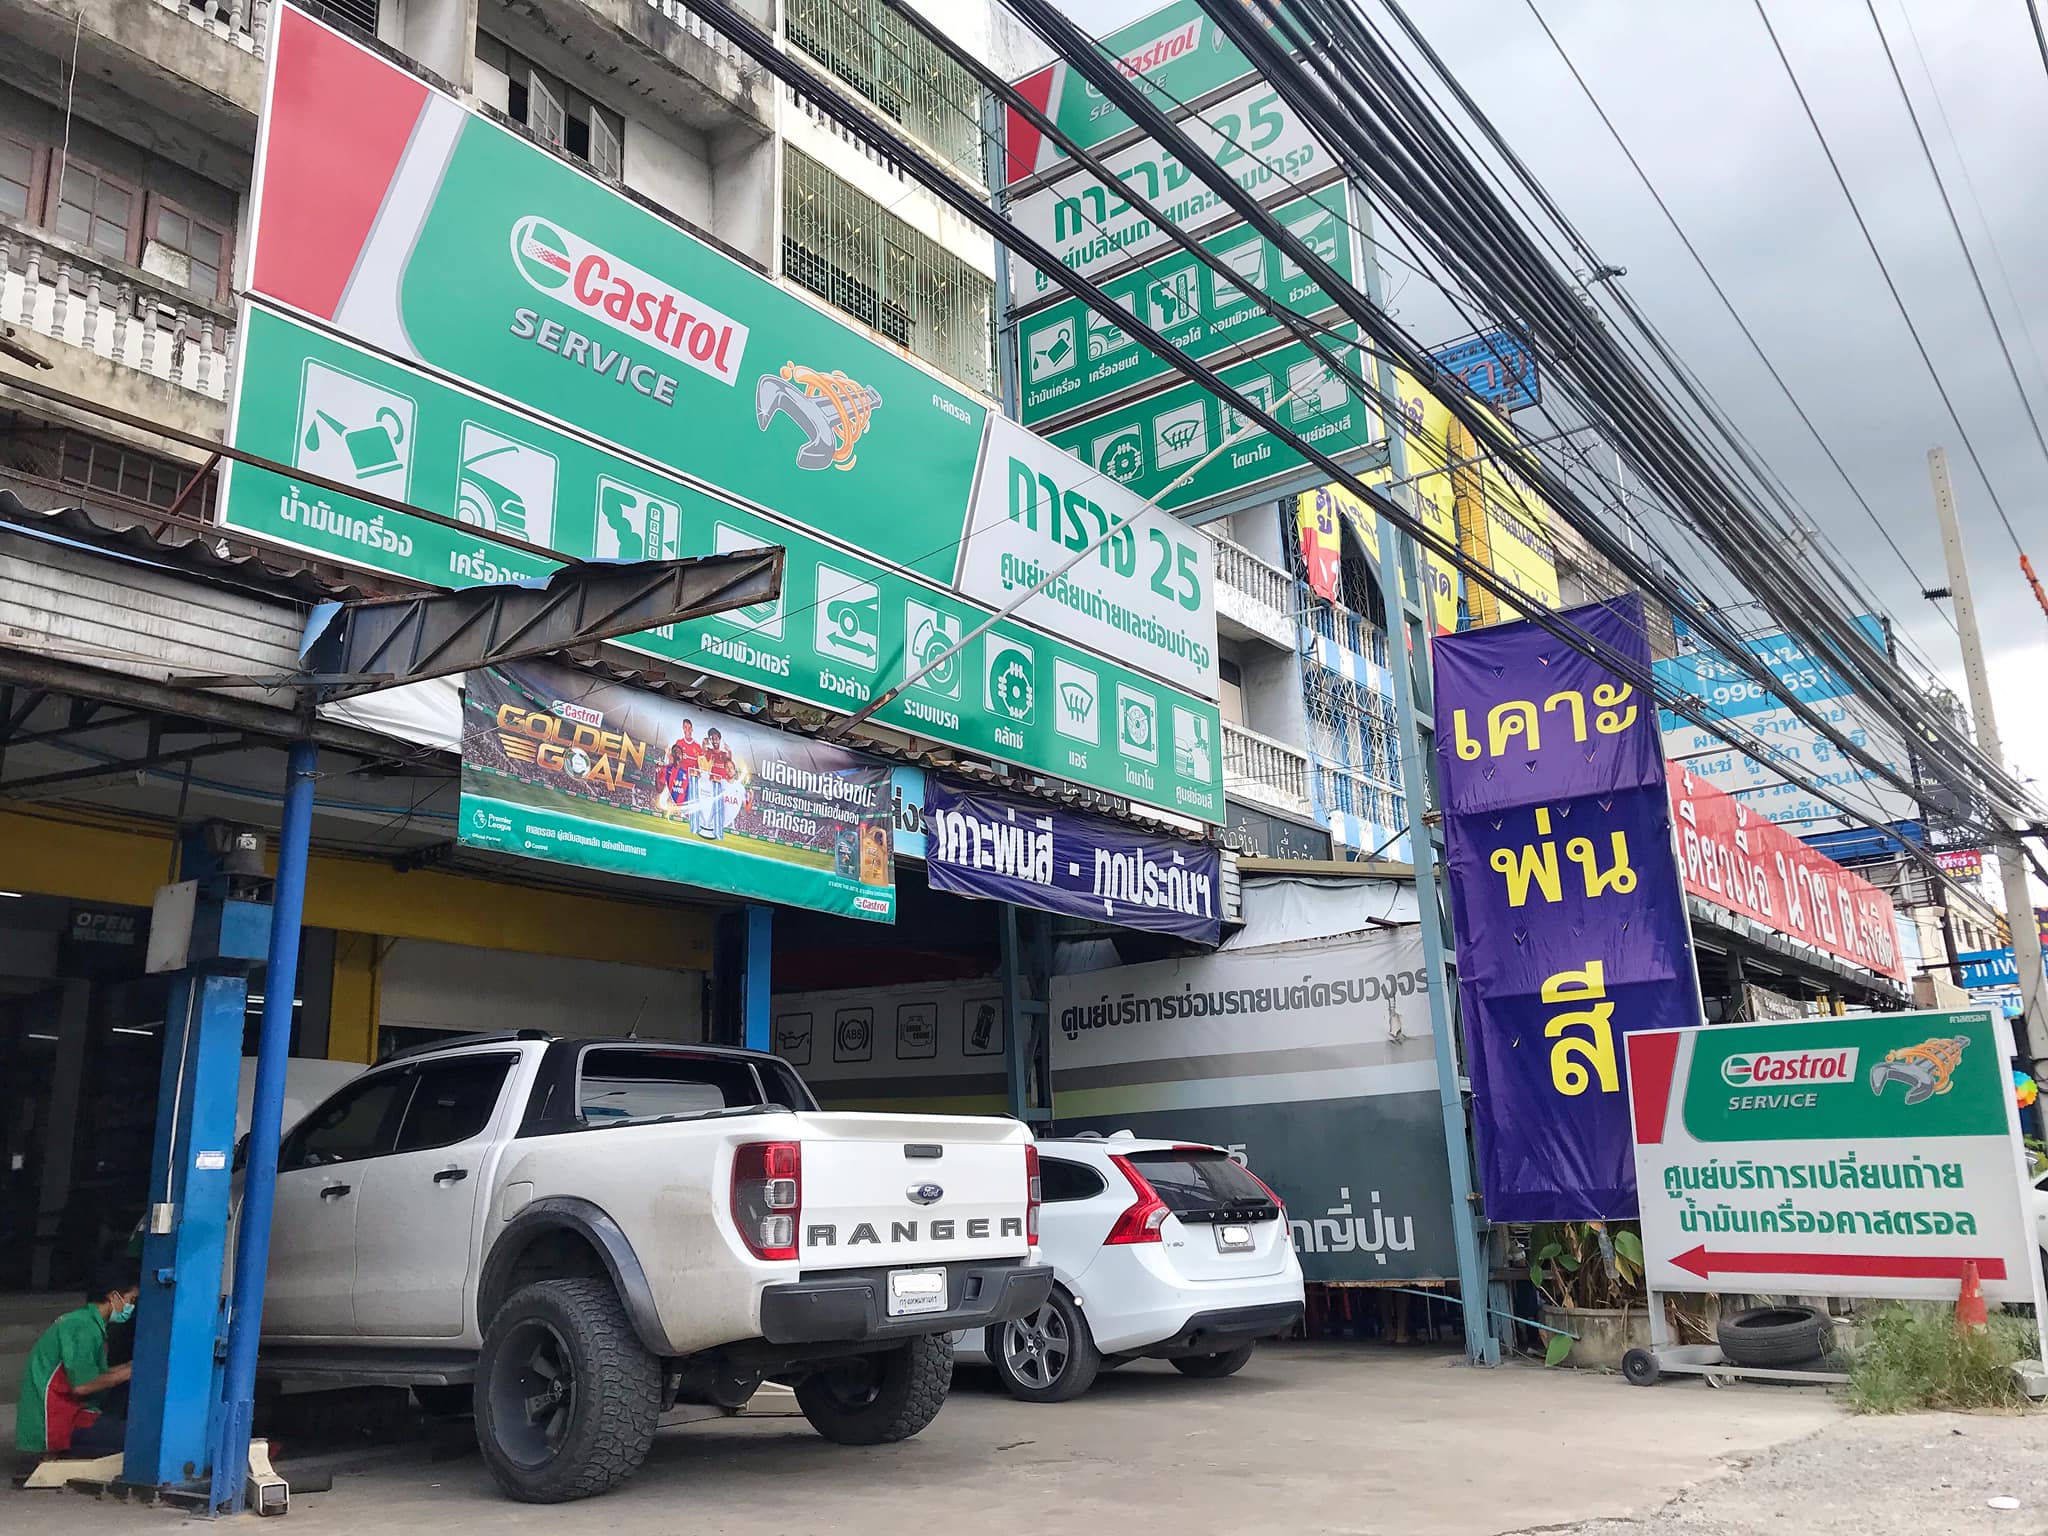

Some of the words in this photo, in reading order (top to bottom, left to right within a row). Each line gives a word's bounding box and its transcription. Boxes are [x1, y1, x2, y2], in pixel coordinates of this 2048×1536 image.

[1115, 24, 1194, 80] Castrol
[1211, 93, 1284, 168] 25
[572, 253, 730, 375] Castrol
[509, 306, 680, 407] SERVICE
[932, 393, 971, 425] คาสตรอล
[1230, 446, 1272, 471] ไดนาโม
[1007, 455, 1137, 579] การาจ
[1148, 527, 1201, 612] 25
[280, 484, 414, 558] น้ำมันเครื่อง
[700, 632, 791, 677] คอมพิวเตอร์
[819, 667, 871, 702] ช่วงล่าง
[1068, 750, 1087, 771] แอร์
[1125, 765, 1155, 791] ไดนาโม
[565, 704, 600, 726] Castrol
[1453, 680, 1638, 762] เคาะ
[497, 703, 647, 770] GOLDEN
[537, 743, 636, 792] GOAL
[488, 813, 513, 825] Premier
[724, 795, 738, 805] AIA
[487, 820, 512, 832] League
[762, 807, 817, 836] คาสตรอล
[935, 808, 1053, 887] เคาะพ่นสี
[1093, 848, 1212, 918] ทุกประกันฯ
[1490, 808, 1637, 908] พ่น
[862, 899, 887, 913] Castrol
[1775, 851, 1837, 946] นาย
[76, 912, 135, 931] OPEN
[845, 1028, 863, 1041] ABS
[1541, 960, 1621, 1096] สี
[1753, 1052, 1848, 1083] Castrol
[1728, 1092, 1818, 1111] SERVICE
[922, 1186, 941, 1198] Ford
[1663, 1150, 1964, 1199] ศูนย์บริการเปลี่ยนถ่าย
[806, 1217, 1023, 1247] RANGER
[1680, 1198, 1978, 1236] น้ำมันเครื่องคาสตรอล
